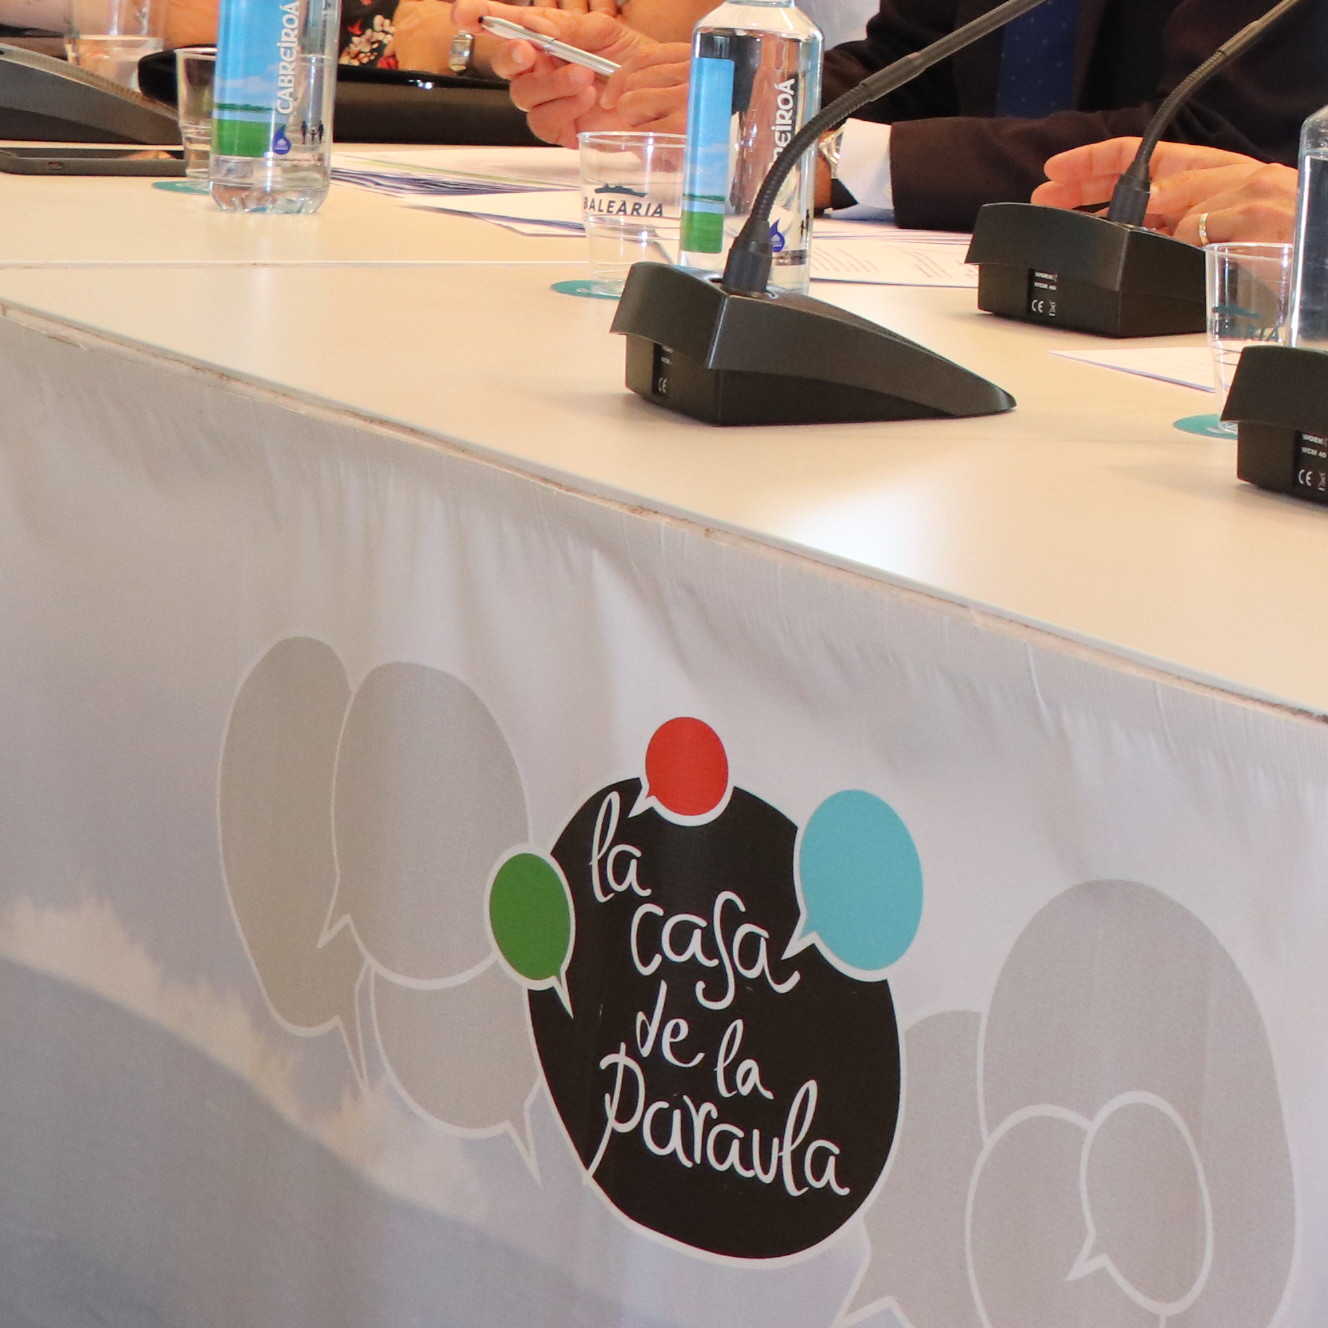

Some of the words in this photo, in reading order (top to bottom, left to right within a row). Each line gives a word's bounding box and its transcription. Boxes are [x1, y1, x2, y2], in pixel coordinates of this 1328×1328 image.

[589, 790, 653, 903] la
[630, 890, 801, 1011] casa
[635, 979, 705, 1068] de
[713, 1018, 775, 1101] la
